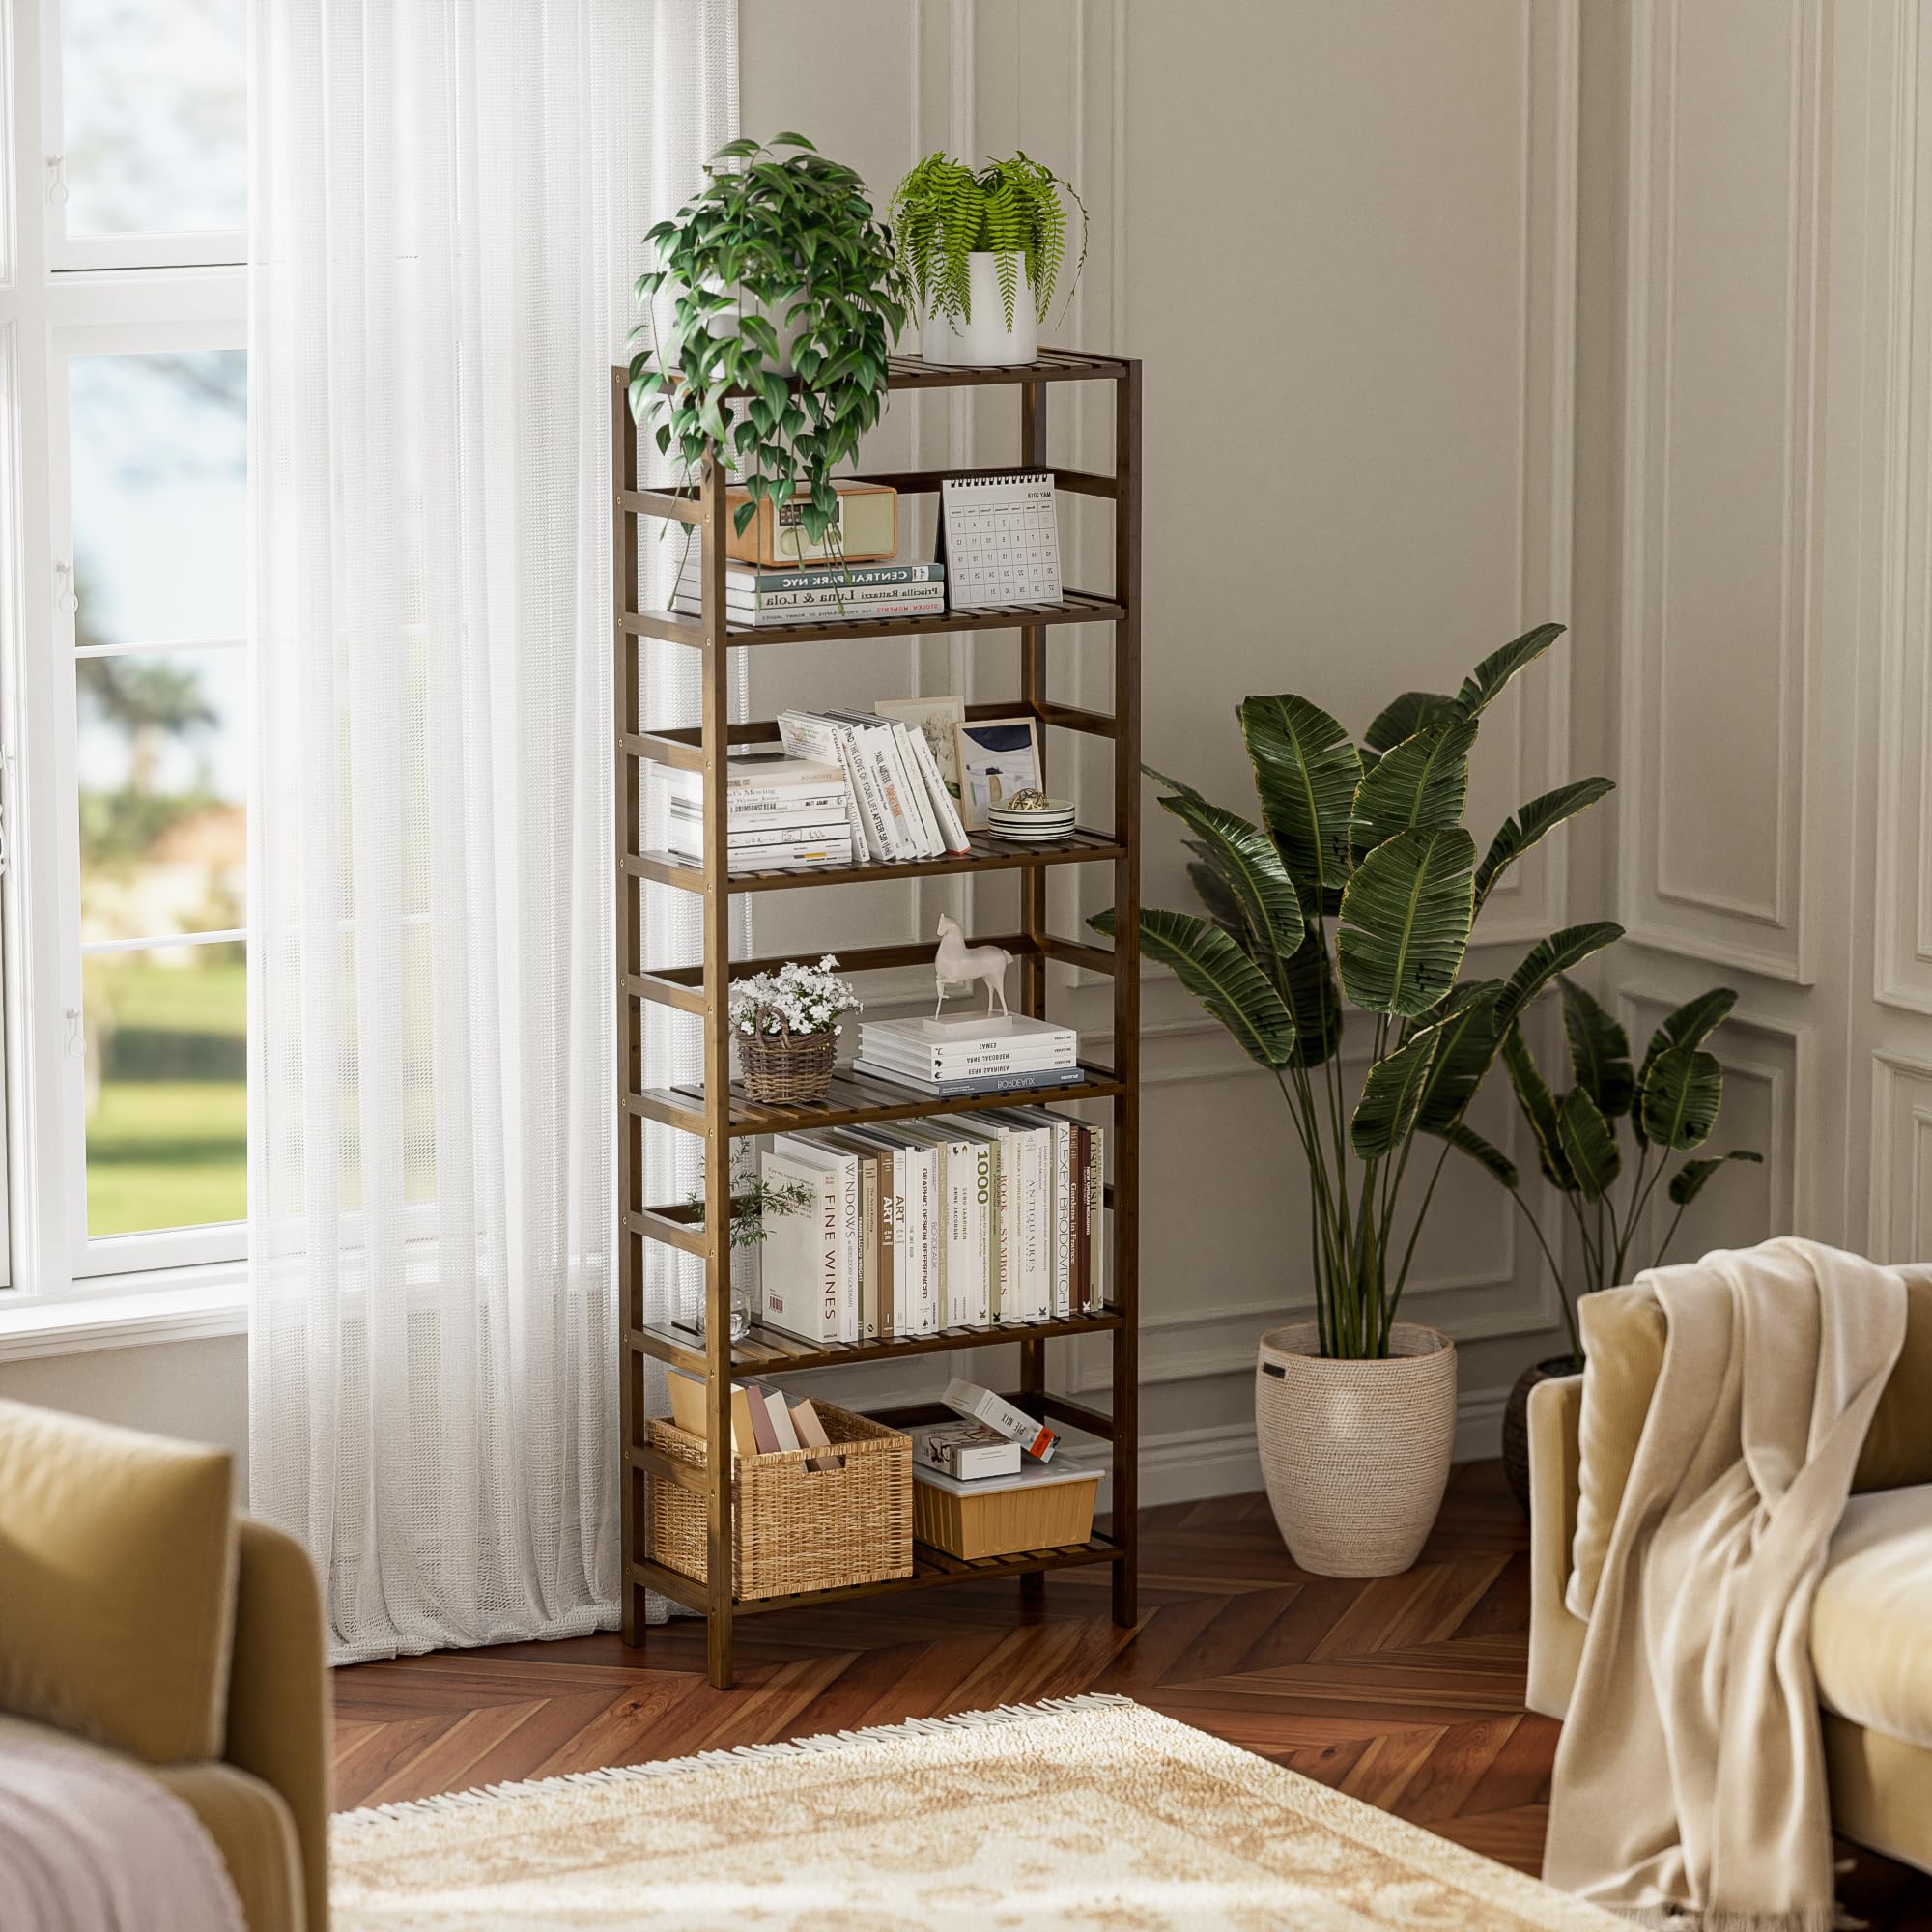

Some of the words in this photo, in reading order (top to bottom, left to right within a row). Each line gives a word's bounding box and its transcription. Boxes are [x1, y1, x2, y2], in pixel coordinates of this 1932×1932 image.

[843, 727, 855, 743] FIND
[848, 742, 860, 755] THE
[873, 751, 885, 765] PAUL
[853, 754, 866, 772] LOVE
[859, 772, 868, 781] OF
[878, 764, 892, 784] AUSTER
[861, 781, 873, 800] YOUR
[867, 799, 878, 812] LIFE
[871, 812, 885, 834] AFTER
[1060, 1128, 1068, 1191] ALEXEY
[978, 1151, 988, 1204] 1000
[845, 1162, 855, 1238] WINDOWS
[825, 1194, 835, 1240] FINE
[883, 1196, 893, 1225] ART
[1071, 1222, 1076, 1231] in
[1059, 1198, 1068, 1304] BRODOVITCH
[825, 1250, 835, 1320] WINES
[1001, 1412, 1016, 1427] MIX
[1013, 1422, 1026, 1435] PIE
